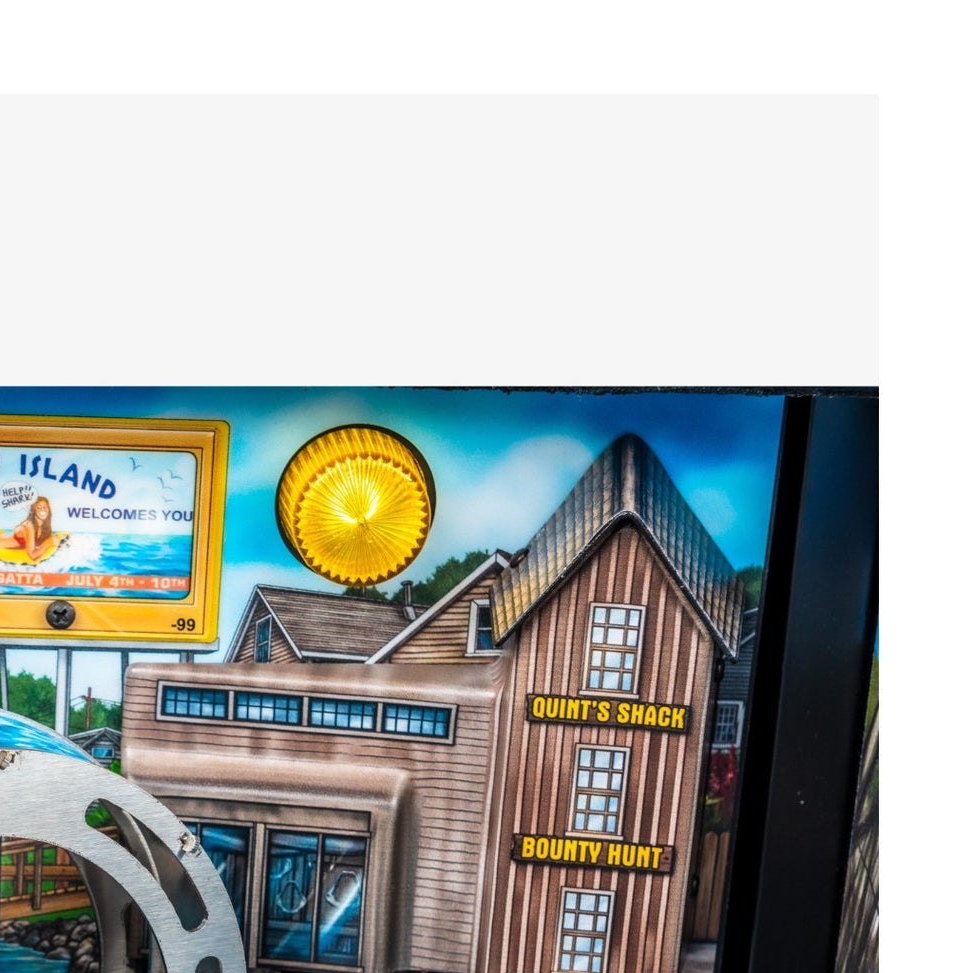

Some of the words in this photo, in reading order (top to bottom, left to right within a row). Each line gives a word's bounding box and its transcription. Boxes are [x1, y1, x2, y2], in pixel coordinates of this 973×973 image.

[20, 453, 117, 500] ISLAND
[67, 507, 157, 521] WELCOMES
[162, 510, 194, 522] YOU
[66, 575, 104, 587] JULY
[109, 576, 134, 587] 4TH
[151, 578, 186, 589] 10TH
[171, 618, 196, 632] -99
[532, 696, 610, 722] QUINT'S
[616, 702, 686, 729] SHACK
[521, 836, 603, 865] BOUNTY
[607, 843, 663, 869] HUNT
